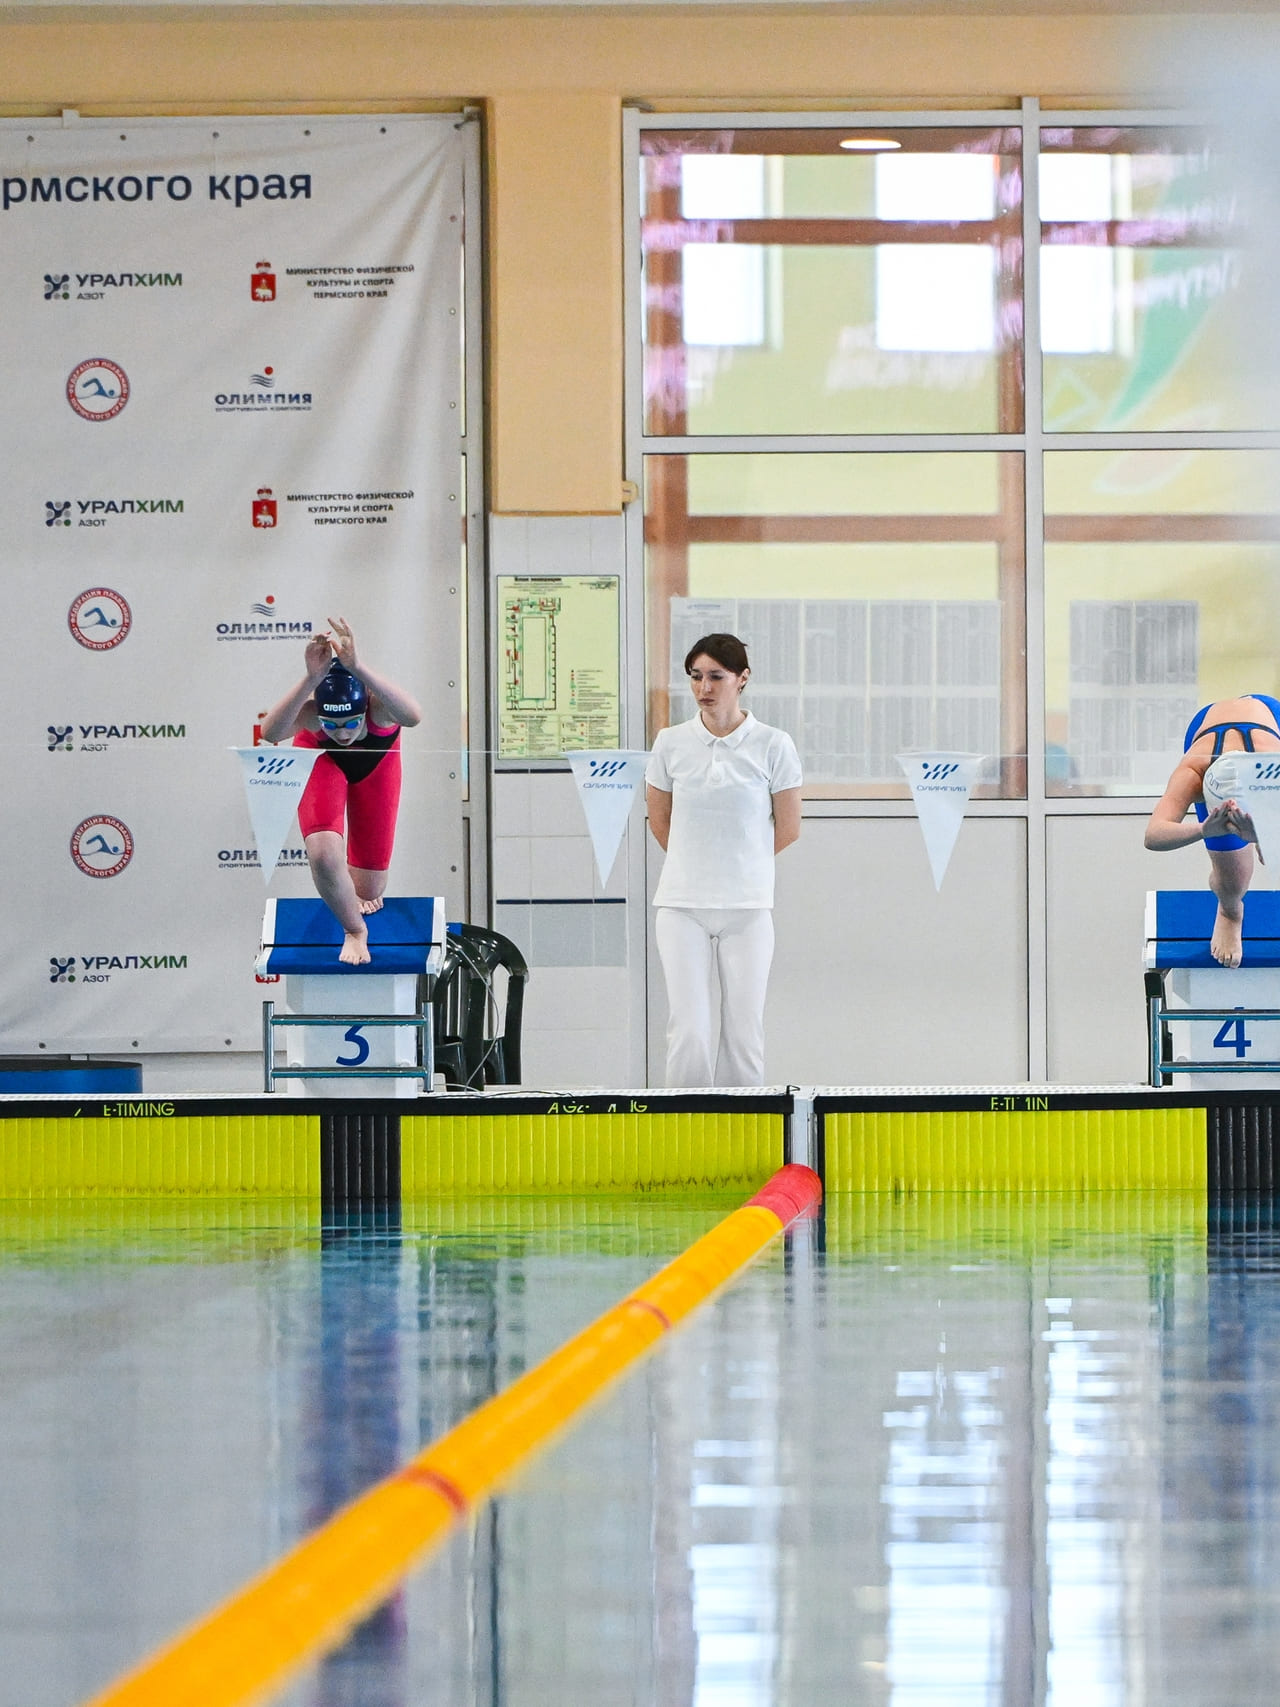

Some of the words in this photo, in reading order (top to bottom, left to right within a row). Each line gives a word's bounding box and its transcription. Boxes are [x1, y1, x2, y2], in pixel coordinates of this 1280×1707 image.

[2, 175, 192, 211] рмского
[208, 173, 312, 209] края
[76, 273, 183, 288] УРАЛХИМ
[76, 292, 106, 300] АЗОТ
[215, 393, 312, 406] ОЛИМПИЯ
[287, 494, 353, 502] МИНИСТЕРСТВО
[355, 490, 415, 501] ФИЗИЧЕСКОЙ
[77, 499, 184, 515] УРАЛХИМ
[308, 505, 351, 513] КУЛЬТУРЫ
[362, 504, 394, 512] СПОРТА
[78, 518, 107, 527] АЗОТ
[366, 516, 387, 524] КРАЯ
[216, 622, 313, 634] ОЛИМПИЯ
[322, 702, 352, 713] arena
[79, 724, 186, 739] УРАЛХИМ
[81, 743, 109, 752] АЗОТ
[72, 817, 105, 851] ФЕДЕРАЦИЯ
[217, 849, 308, 861] ОЛИПИ
[74, 853, 115, 878] ПЕРМСКОГО
[81, 956, 187, 971] УРАЛХИМ
[82, 974, 111, 983] АЗОТ
[1213, 1007, 1252, 1058] 4
[336, 1021, 370, 1067] 3
